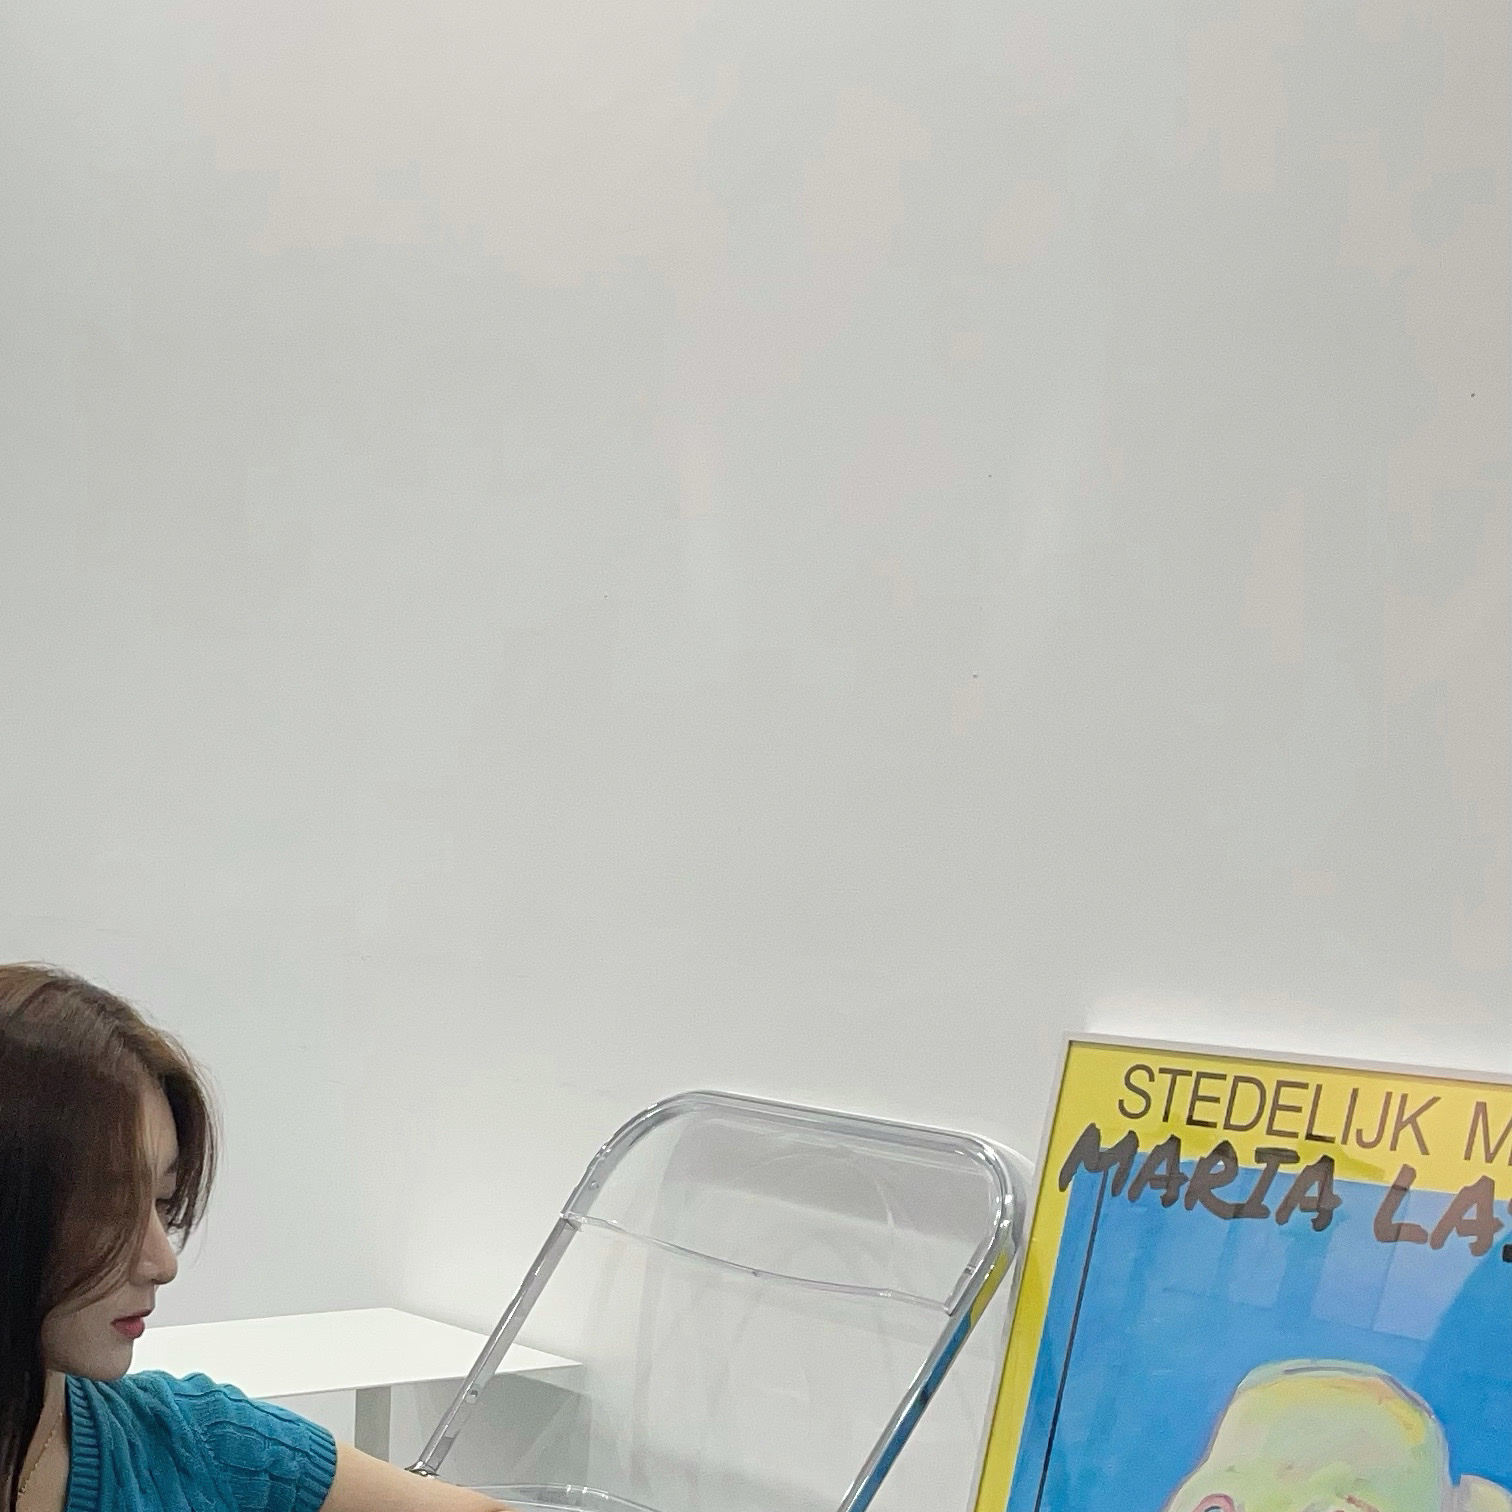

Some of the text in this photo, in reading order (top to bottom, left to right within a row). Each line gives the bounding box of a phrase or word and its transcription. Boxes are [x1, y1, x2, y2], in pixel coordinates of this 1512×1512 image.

[1118, 1063, 1442, 1156] STEDELIJK
[1058, 1122, 1512, 1257] MARIA LA
